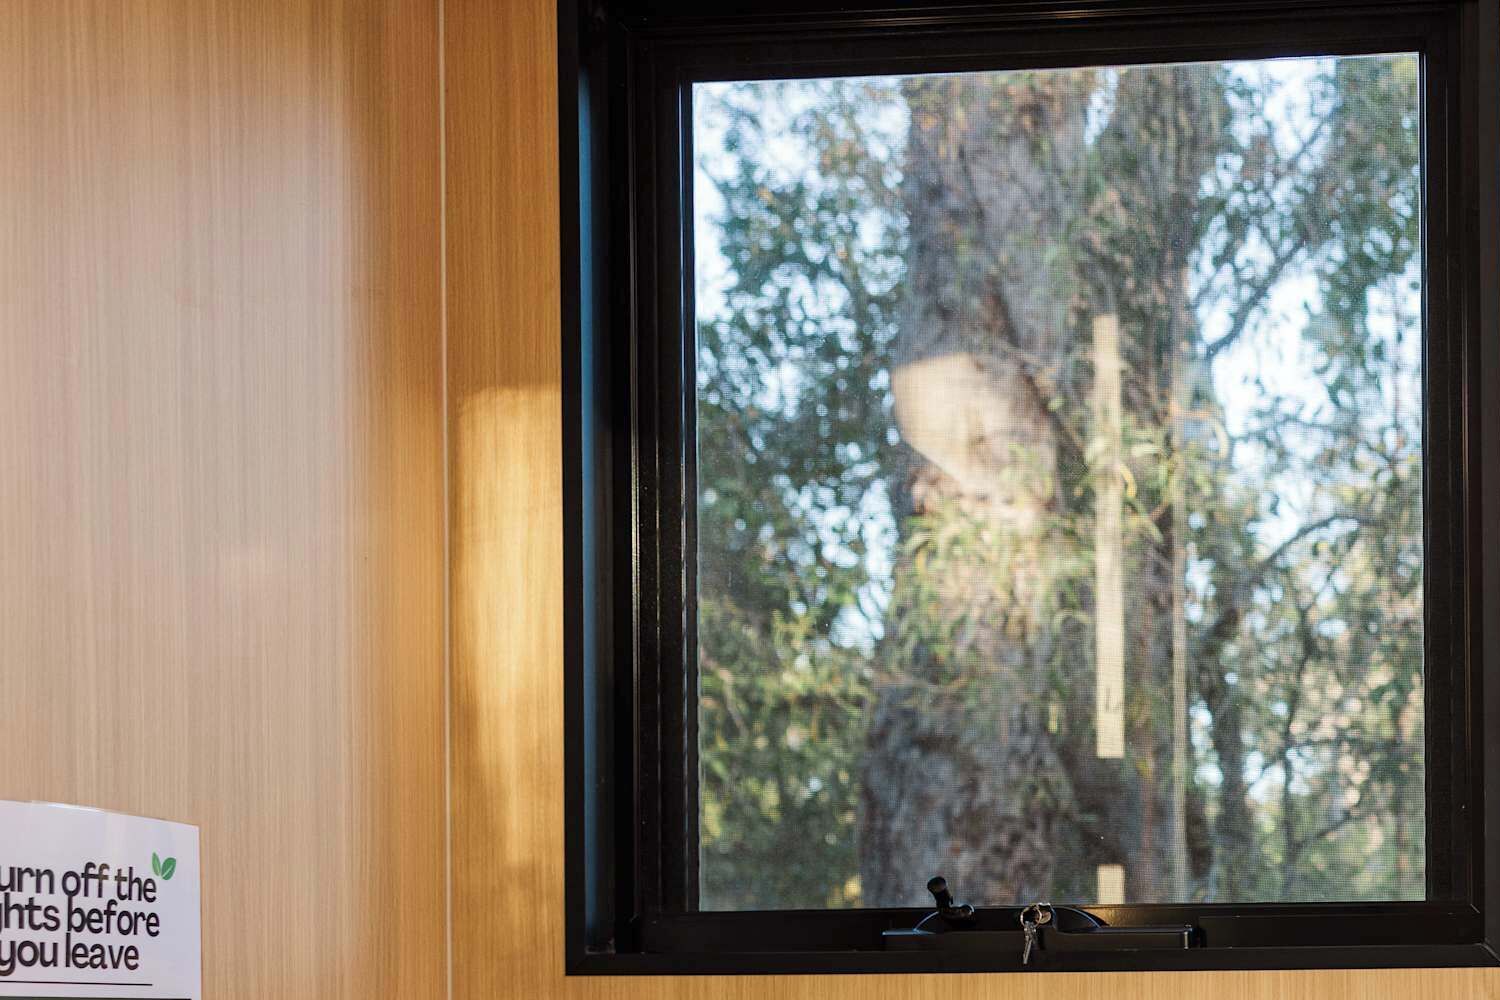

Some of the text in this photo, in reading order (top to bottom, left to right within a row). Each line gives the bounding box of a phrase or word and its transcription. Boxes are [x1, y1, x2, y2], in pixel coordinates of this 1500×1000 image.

[62, 861, 110, 898] off
[114, 866, 157, 903] the
[67, 895, 160, 938] before
[66, 932, 139, 970] leave
